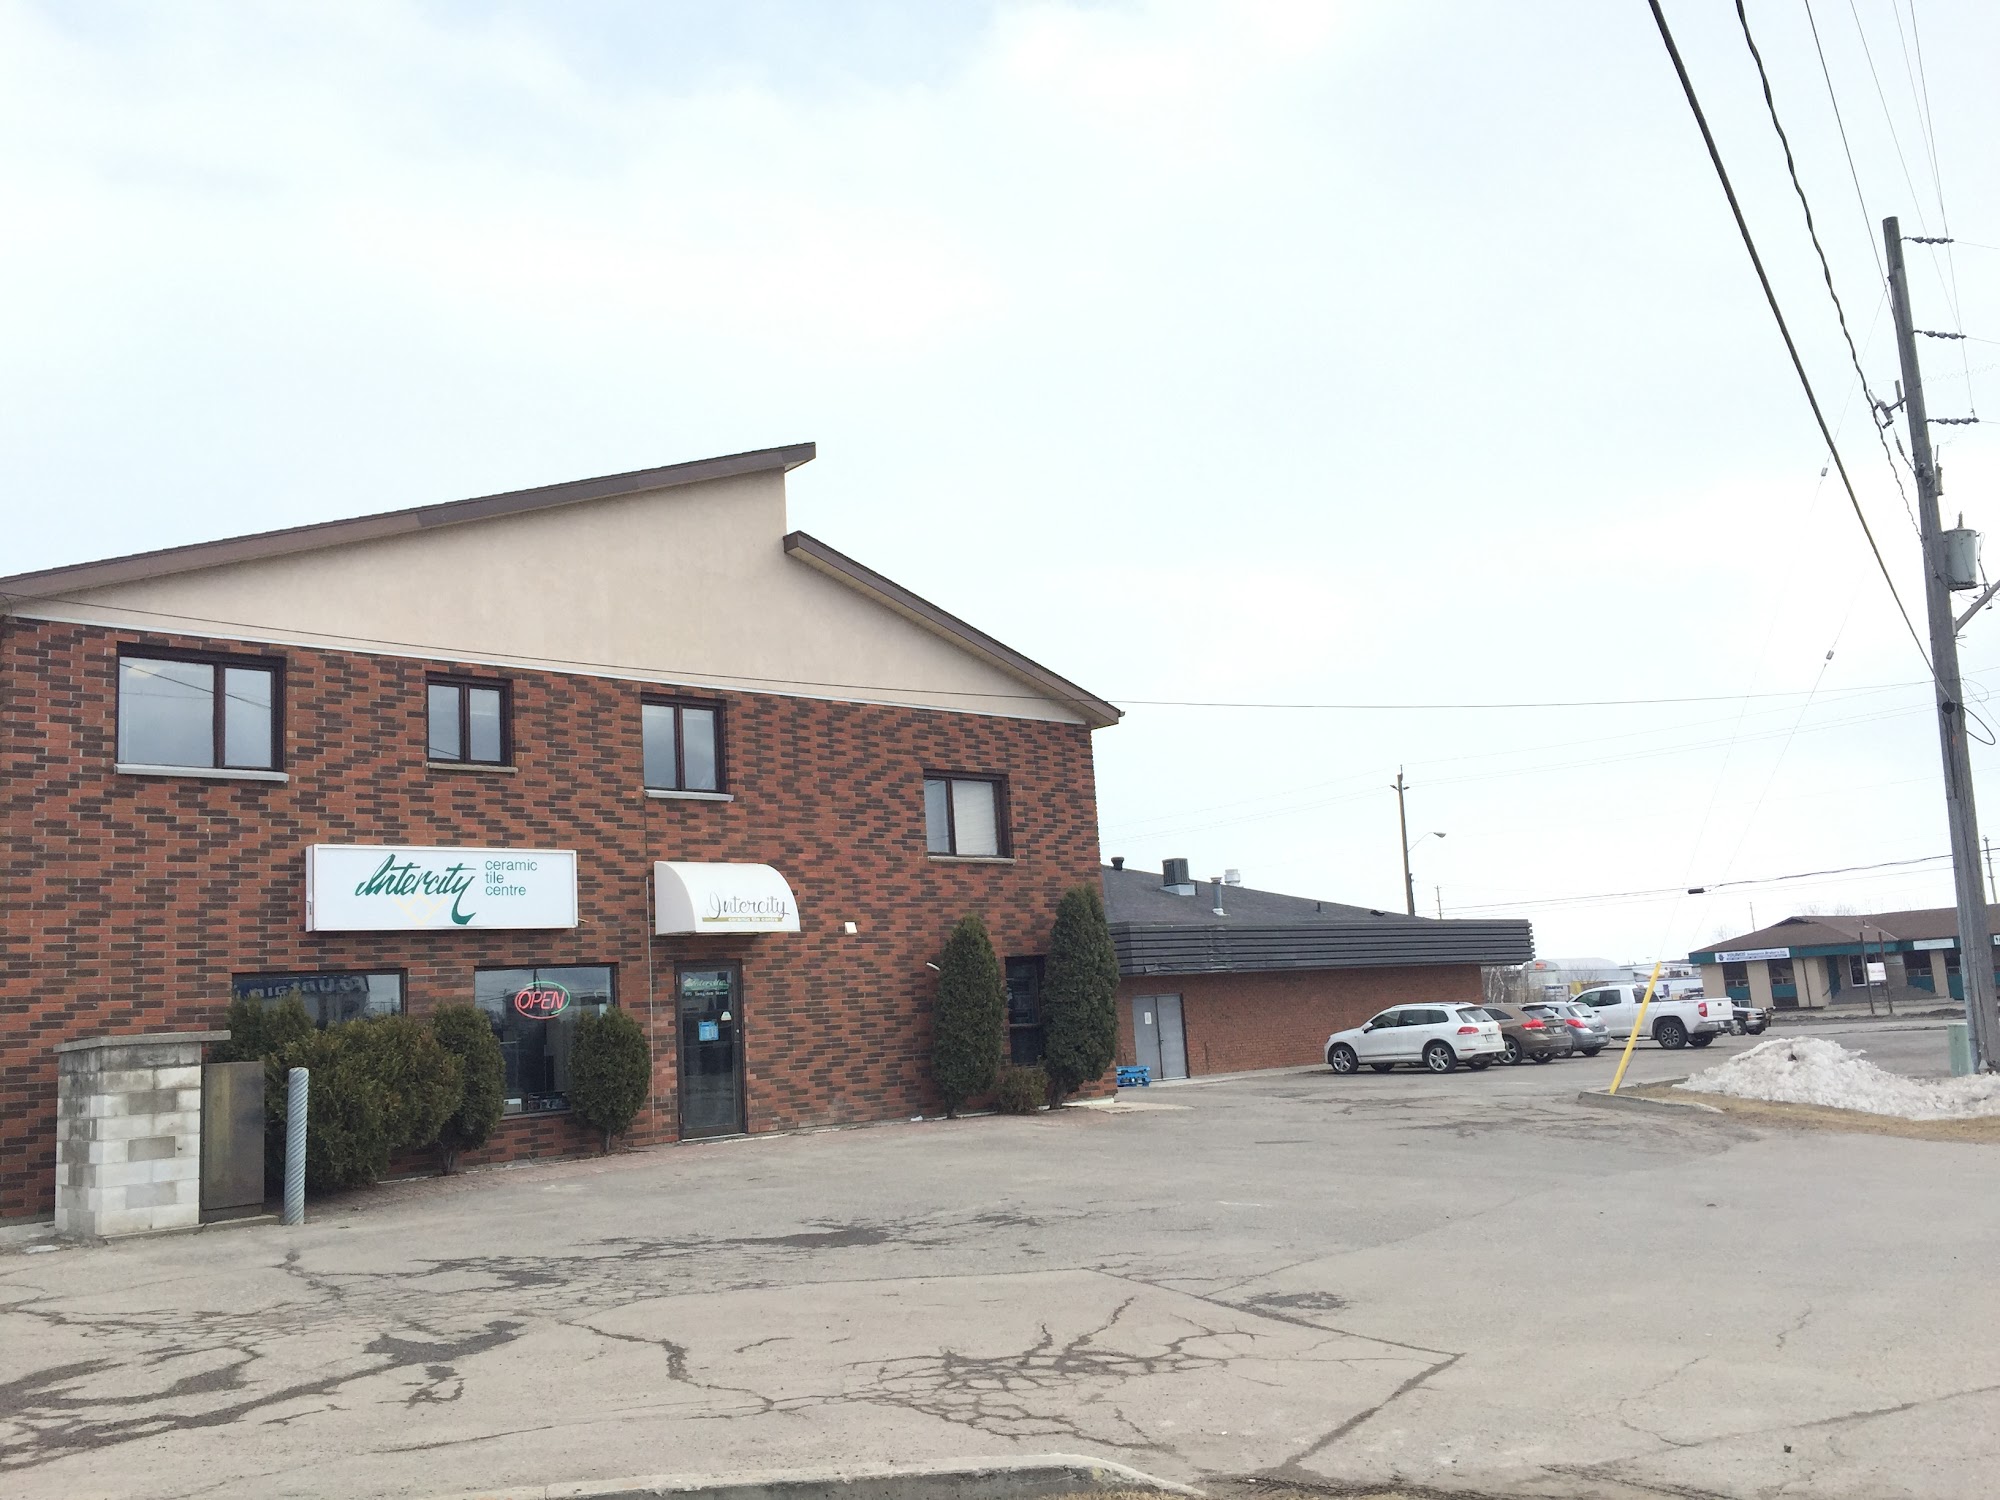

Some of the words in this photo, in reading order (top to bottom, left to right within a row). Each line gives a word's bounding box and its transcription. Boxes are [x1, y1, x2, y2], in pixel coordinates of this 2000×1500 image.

[485, 859, 538, 872] ceramic
[485, 872, 504, 884] tile
[354, 853, 477, 925] Intercity
[485, 884, 527, 896] centre
[706, 891, 790, 919] Intercity
[518, 990, 565, 1010] OPEN
